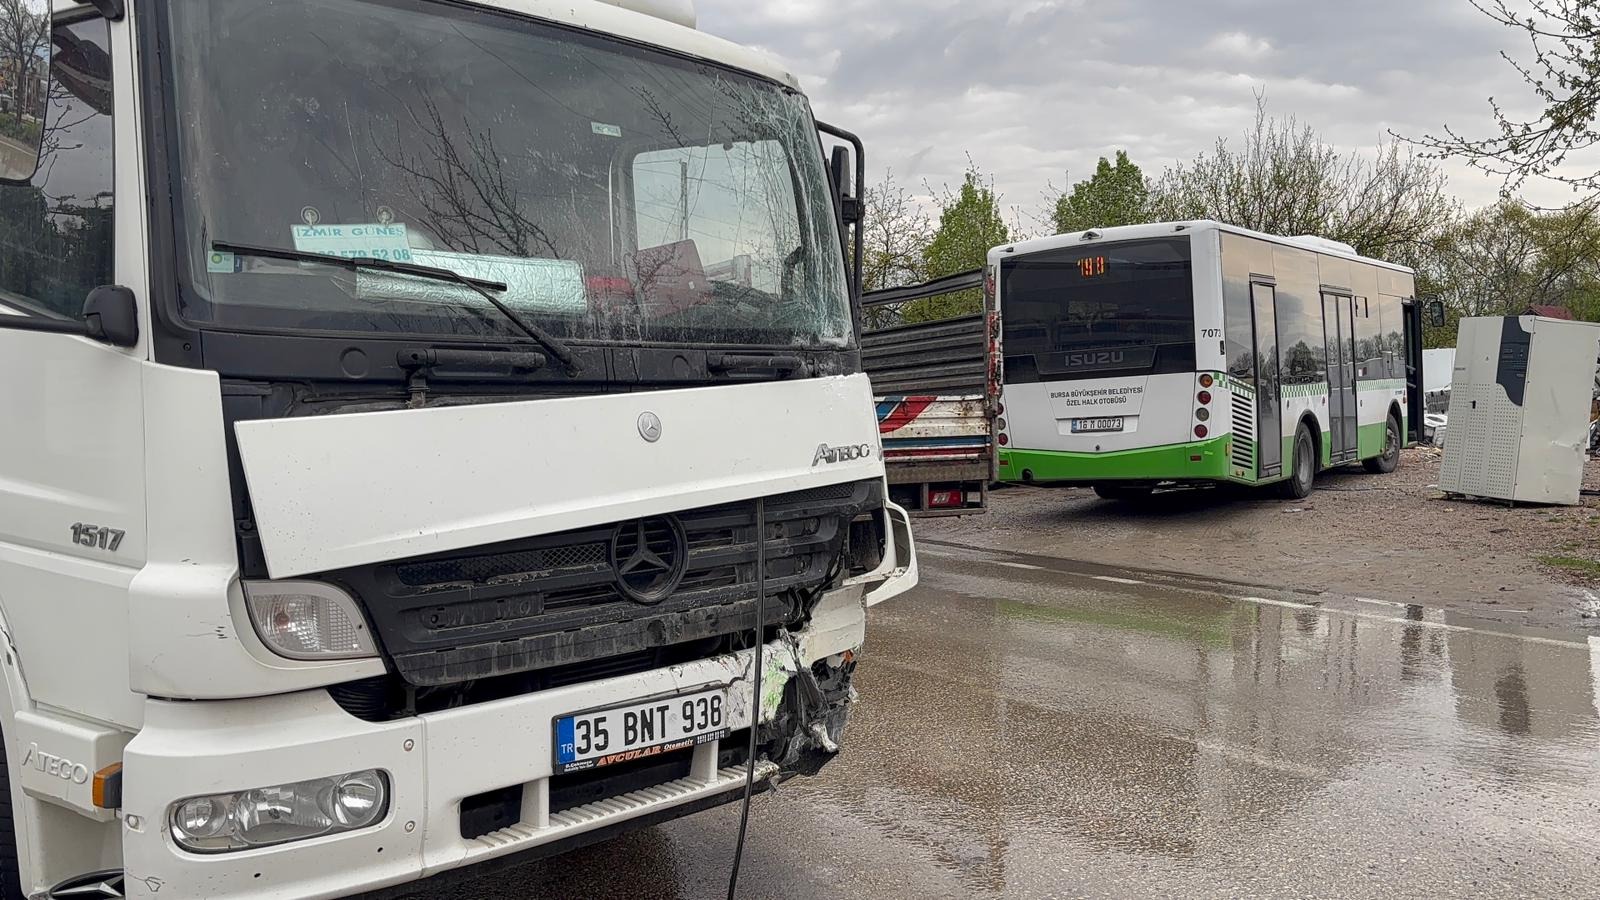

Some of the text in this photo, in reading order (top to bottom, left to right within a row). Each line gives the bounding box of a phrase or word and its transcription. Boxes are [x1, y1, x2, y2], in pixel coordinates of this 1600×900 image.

[392, 248, 411, 261] 08
[1064, 351, 1124, 367] ISUZU
[1050, 391, 1070, 399] BURSA
[1108, 385, 1144, 396] BELEDİYESİ
[1066, 399, 1081, 407] ÖZEL
[1082, 398, 1099, 406] HALK
[1097, 418, 1121, 429] 00073
[69, 522, 126, 552] 1517
[561, 694, 723, 755] TR 35 BNT 938
[22, 742, 89, 786] ATEGO
[596, 745, 662, 767] AVCULAR
